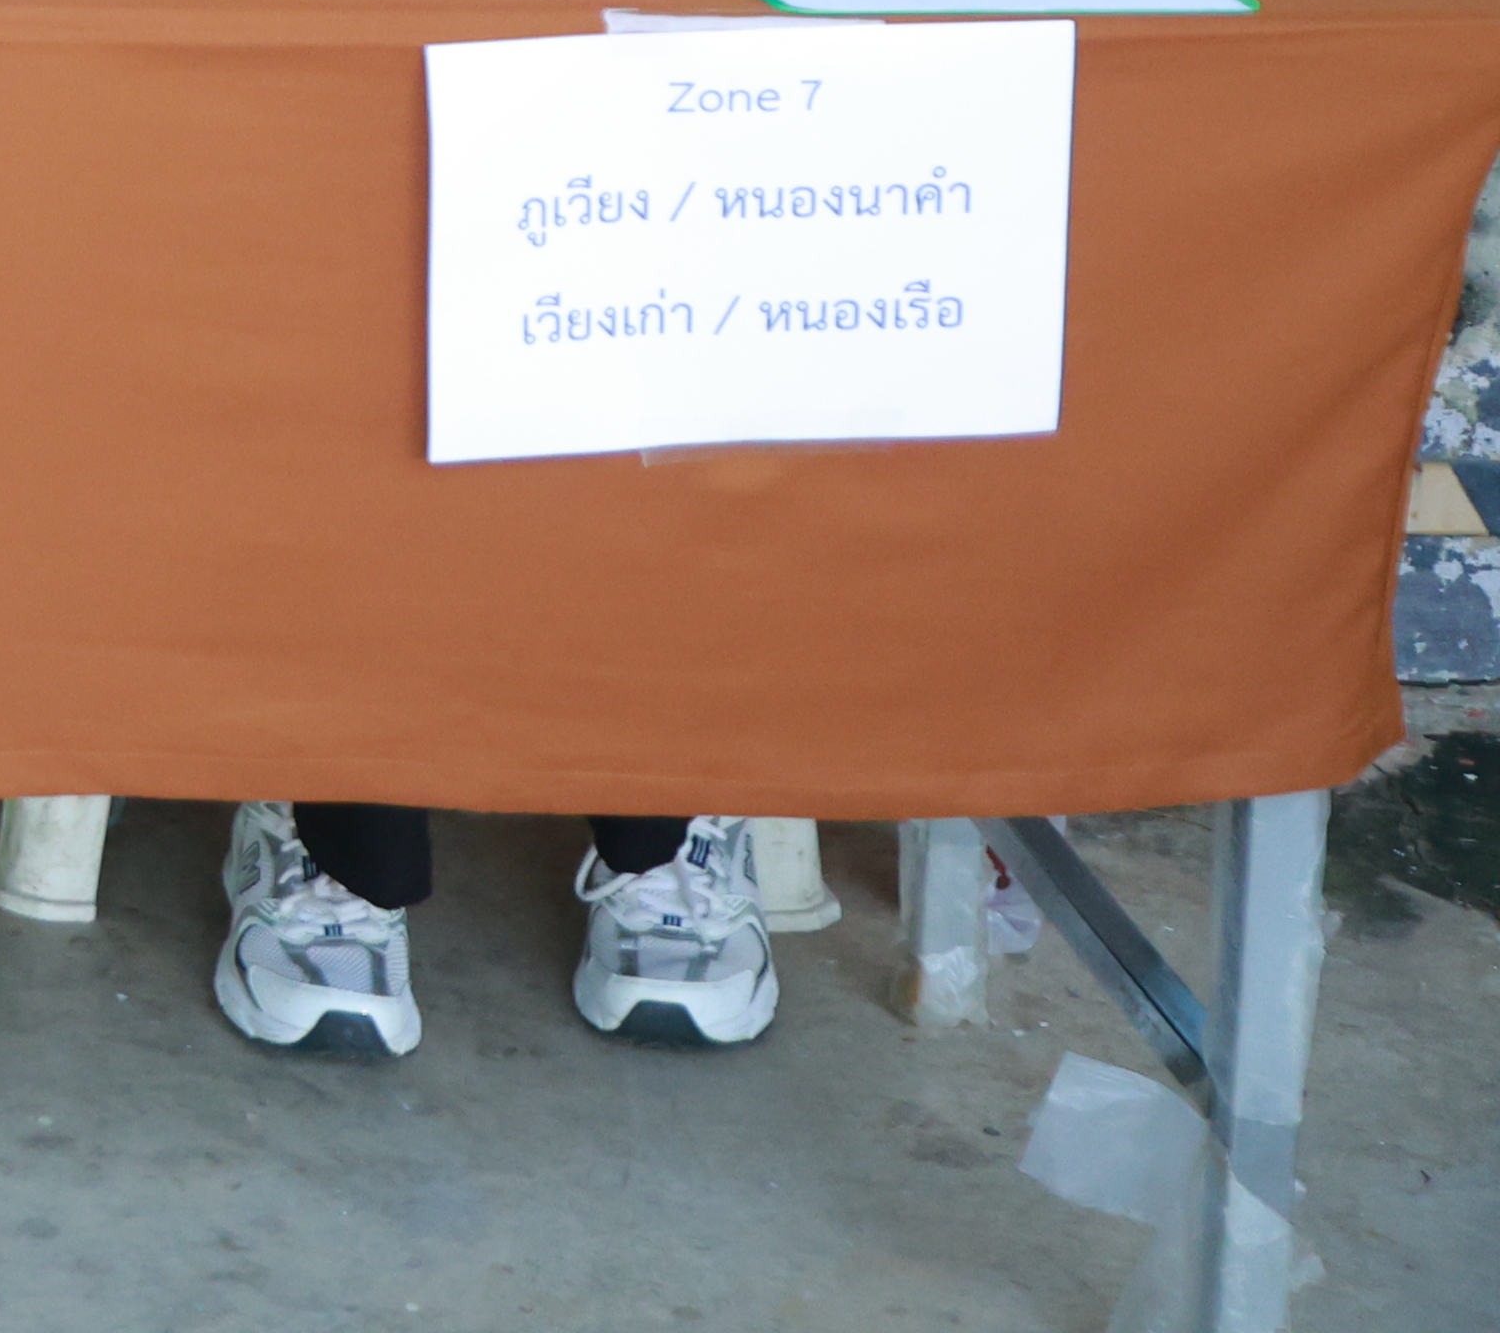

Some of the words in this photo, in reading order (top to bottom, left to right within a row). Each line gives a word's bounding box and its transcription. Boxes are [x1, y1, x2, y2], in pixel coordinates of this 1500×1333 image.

[666, 80, 782, 114] Zone
[800, 78, 824, 112] 7
[516, 173, 650, 249] ภูเวียง
[714, 164, 972, 220] หนองนาคำ
[521, 287, 695, 346] เวียงเก่า
[758, 278, 964, 333] หนองเรือ
